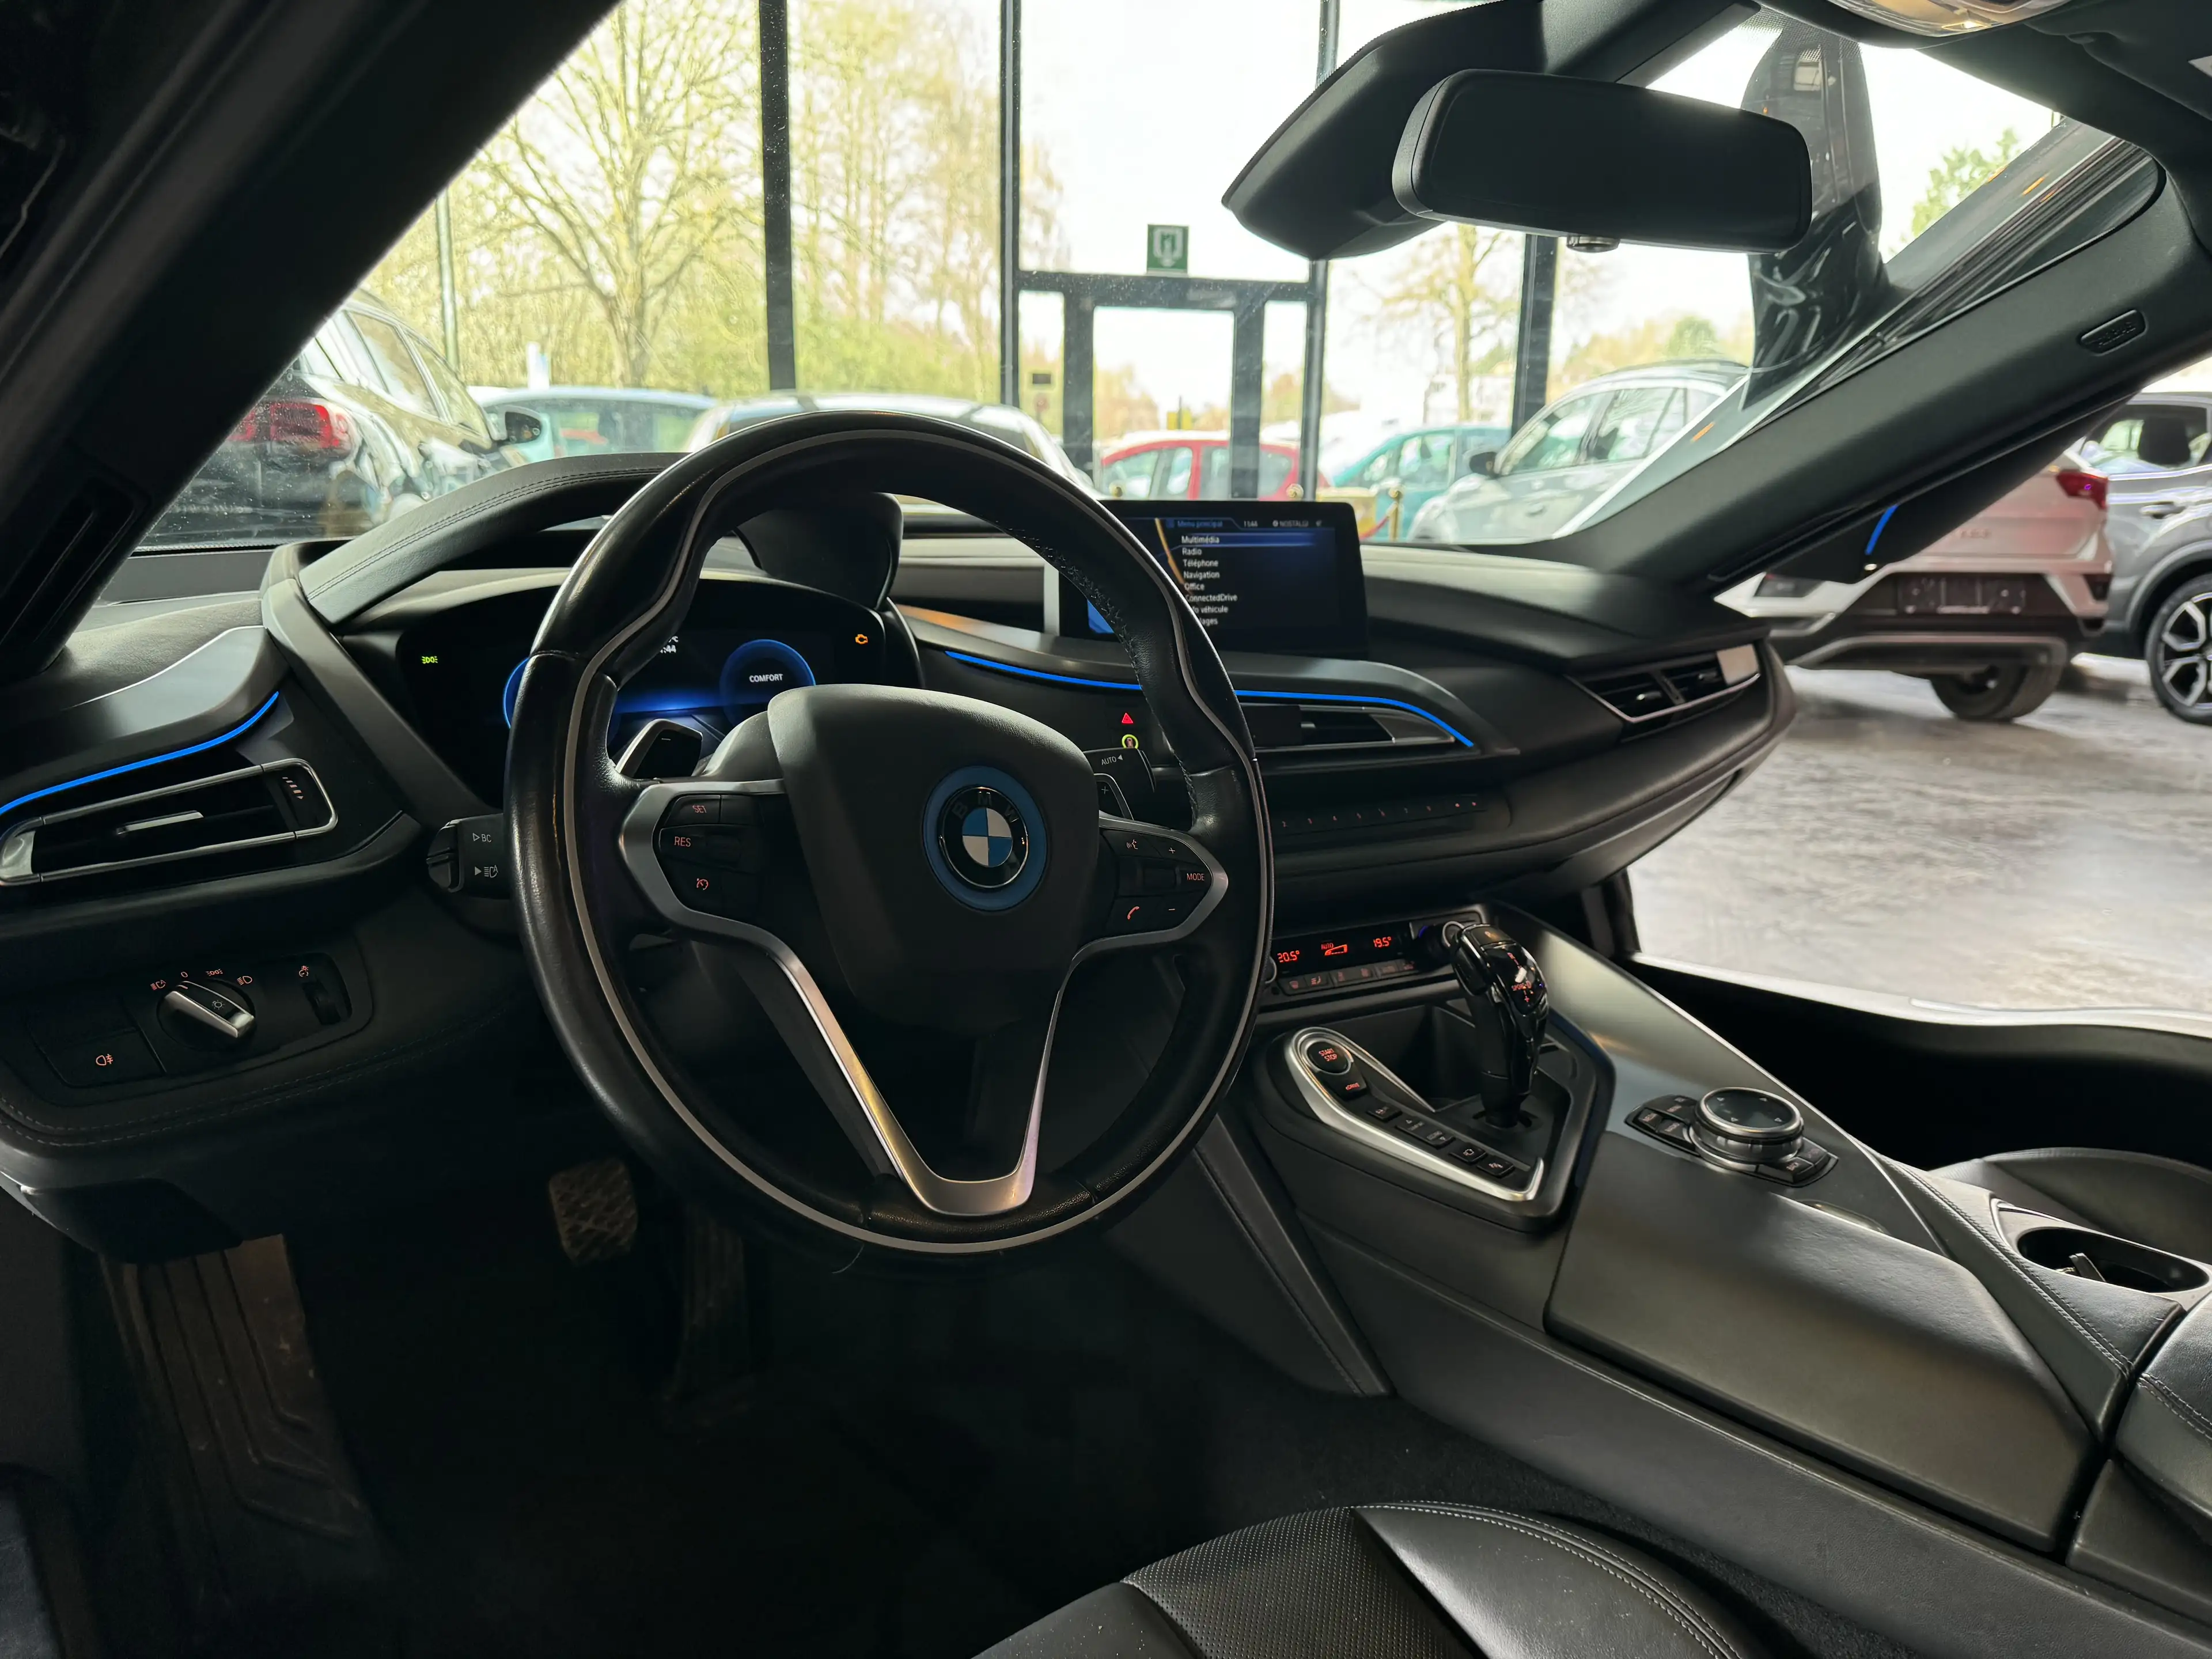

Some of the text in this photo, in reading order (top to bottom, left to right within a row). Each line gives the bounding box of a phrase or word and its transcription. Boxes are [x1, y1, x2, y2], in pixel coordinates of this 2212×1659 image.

[1181, 535, 1219, 543] Multimédia
[1182, 547, 1202, 555] Radio
[1183, 559, 1219, 568] Téléphone
[1184, 571, 1220, 580] Navigation
[749, 673, 783, 683] COMFORT
[1101, 756, 1117, 766] AUTO
[692, 805, 707, 814] SET
[481, 834, 492, 843] BC
[674, 836, 691, 847] RES
[1187, 873, 1205, 881] MODE
[1324, 1053, 1338, 1062] STOP
